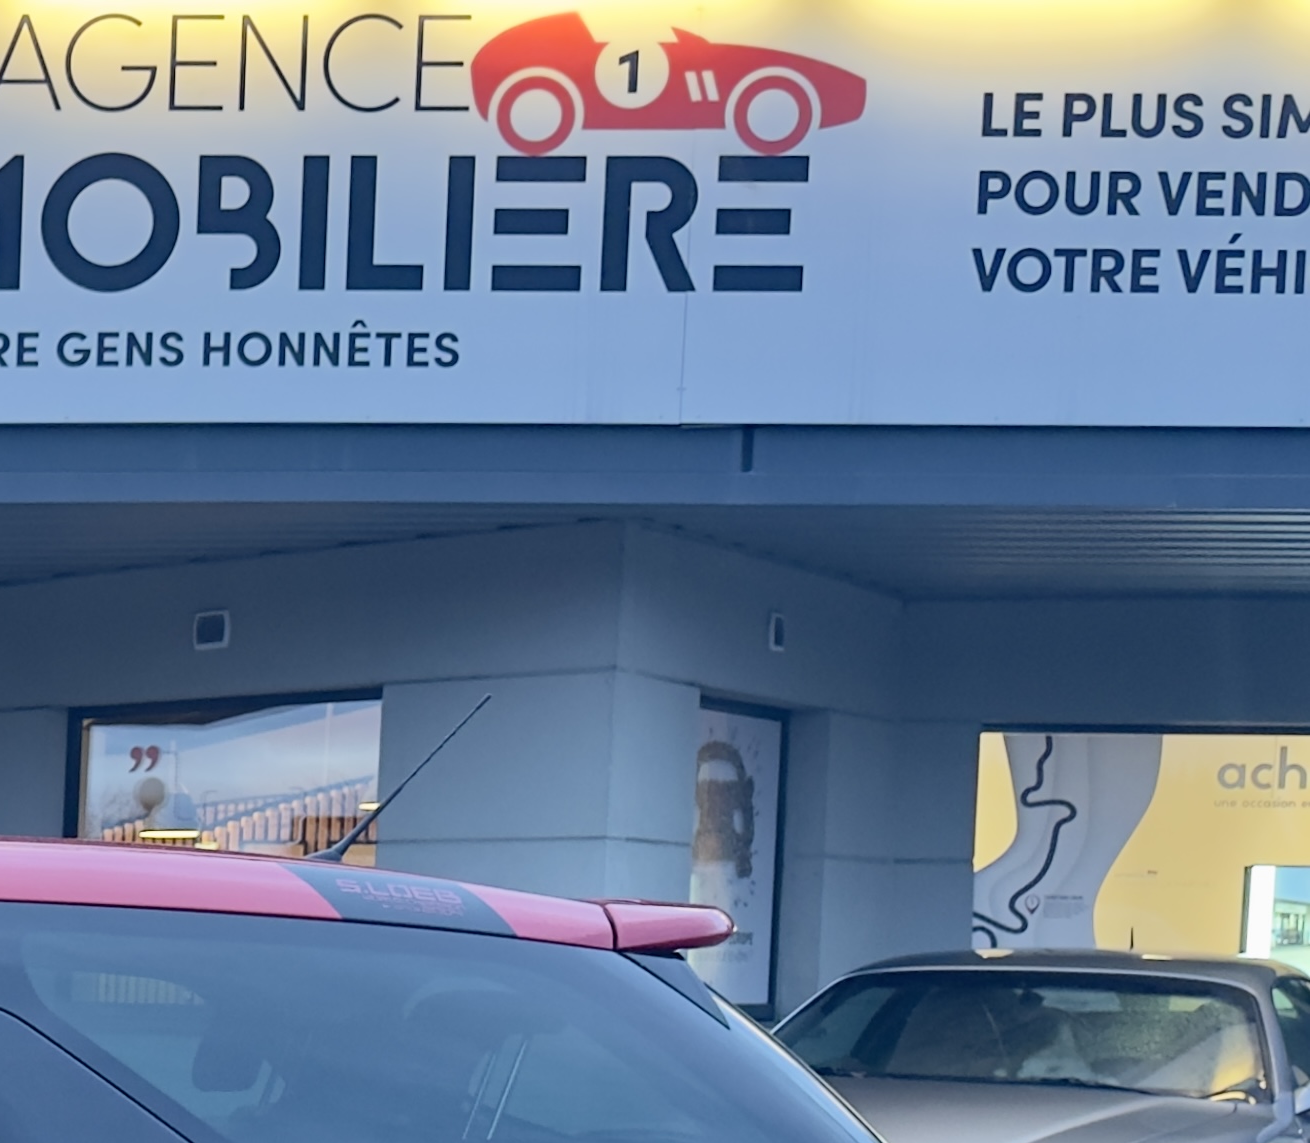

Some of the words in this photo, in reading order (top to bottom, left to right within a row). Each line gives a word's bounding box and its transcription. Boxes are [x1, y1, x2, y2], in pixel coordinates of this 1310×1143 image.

[981, 92, 1044, 138] LE
[1062, 92, 1205, 139] PLUS
[976, 169, 1143, 216] POUR
[1158, 170, 1310, 217] VEND
[971, 247, 1162, 294] VOTRE
[1177, 232, 1308, 295] VÉHI
[56, 331, 186, 370] GENS
[200, 317, 463, 371] HONNÊTES
[1241, 798, 1297, 809] occasion
[335, 877, 463, 905] S.LOEB
